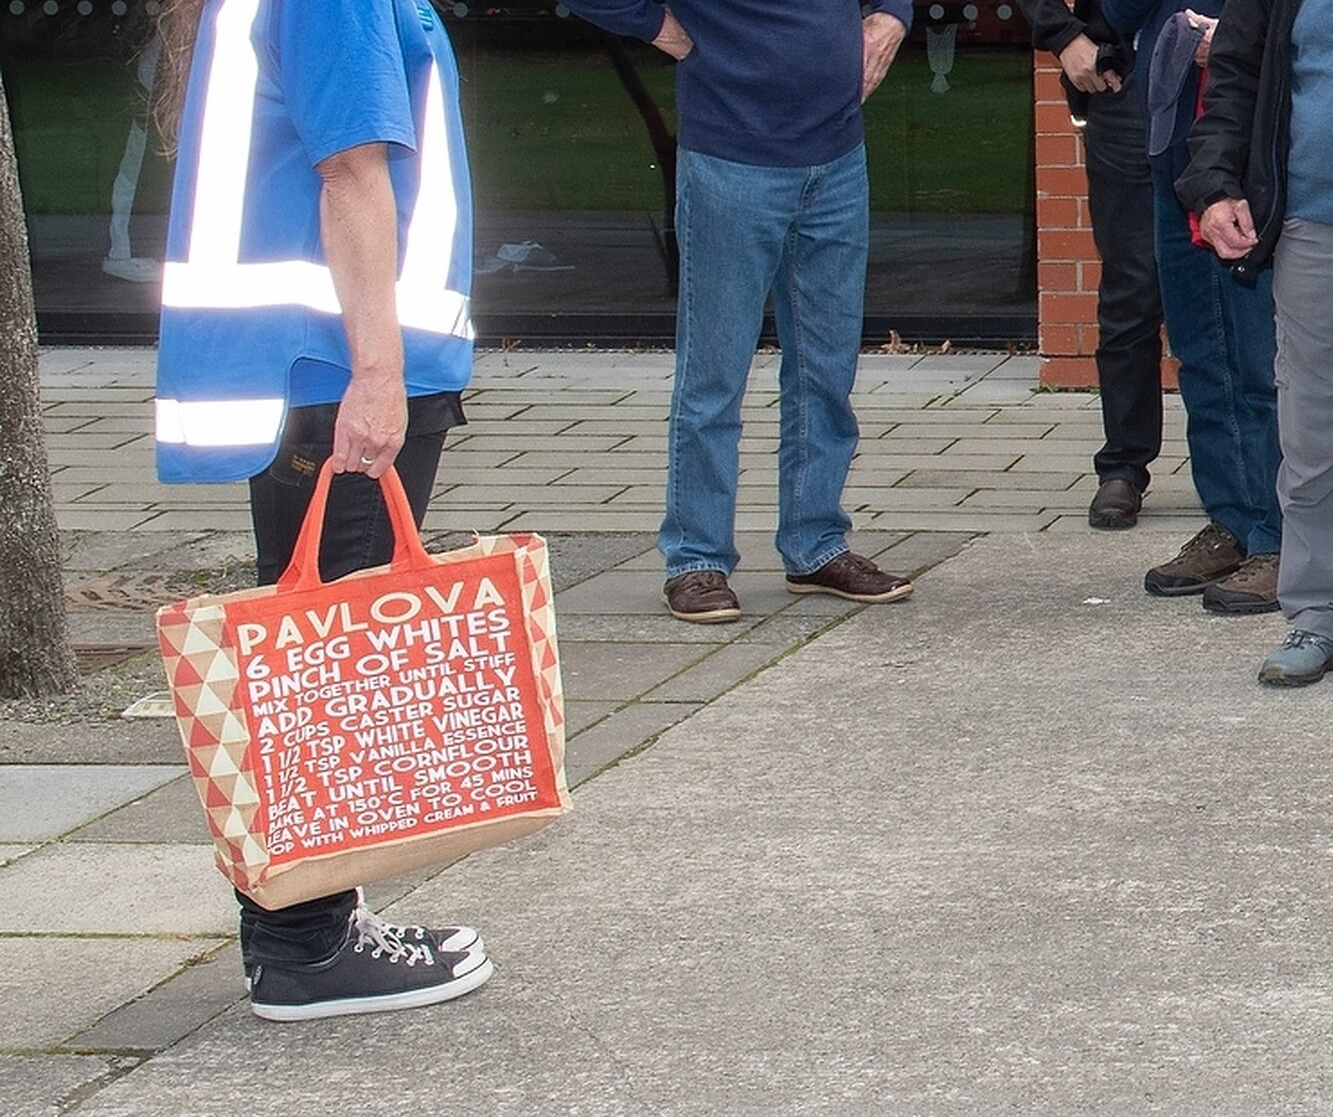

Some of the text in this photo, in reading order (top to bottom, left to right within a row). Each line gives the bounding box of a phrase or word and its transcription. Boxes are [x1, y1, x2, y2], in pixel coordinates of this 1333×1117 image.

[237, 577, 505, 656] PAVLOVA
[246, 608, 511, 679] 6 EGG WHITES
[248, 631, 511, 703] PINCH OF SALT
[252, 652, 516, 717] MIX TOGETHER UNTIL STIFF
[257, 666, 516, 738] ADD GRADUALLY
[260, 687, 520, 754] 2 CUPS CASTER SUGAR
[262, 703, 524, 773] 1 1/2 TSP WHITE VINEGAR
[264, 720, 527, 788] 1 1/2 TSP VANILLA ESSENCE
[266, 735, 529, 804] 1 1/2 TSP CORNFLOUR
[268, 750, 532, 821] BEAT UNTIL SMOOTH
[268, 780, 537, 847] LEAVE IN OVEN TO COOL
[269, 810, 305, 835] BAKE
[313, 804, 339, 821] AT
[410, 782, 452, 801] FOR
[460, 773, 484, 789] 45
[491, 766, 534, 783] MINS
[301, 831, 344, 849] WITH
[349, 818, 418, 839] WHIPPED
[424, 804, 474, 823] CREAM
[480, 801, 491, 812] &
[496, 791, 538, 807] FRUIT
